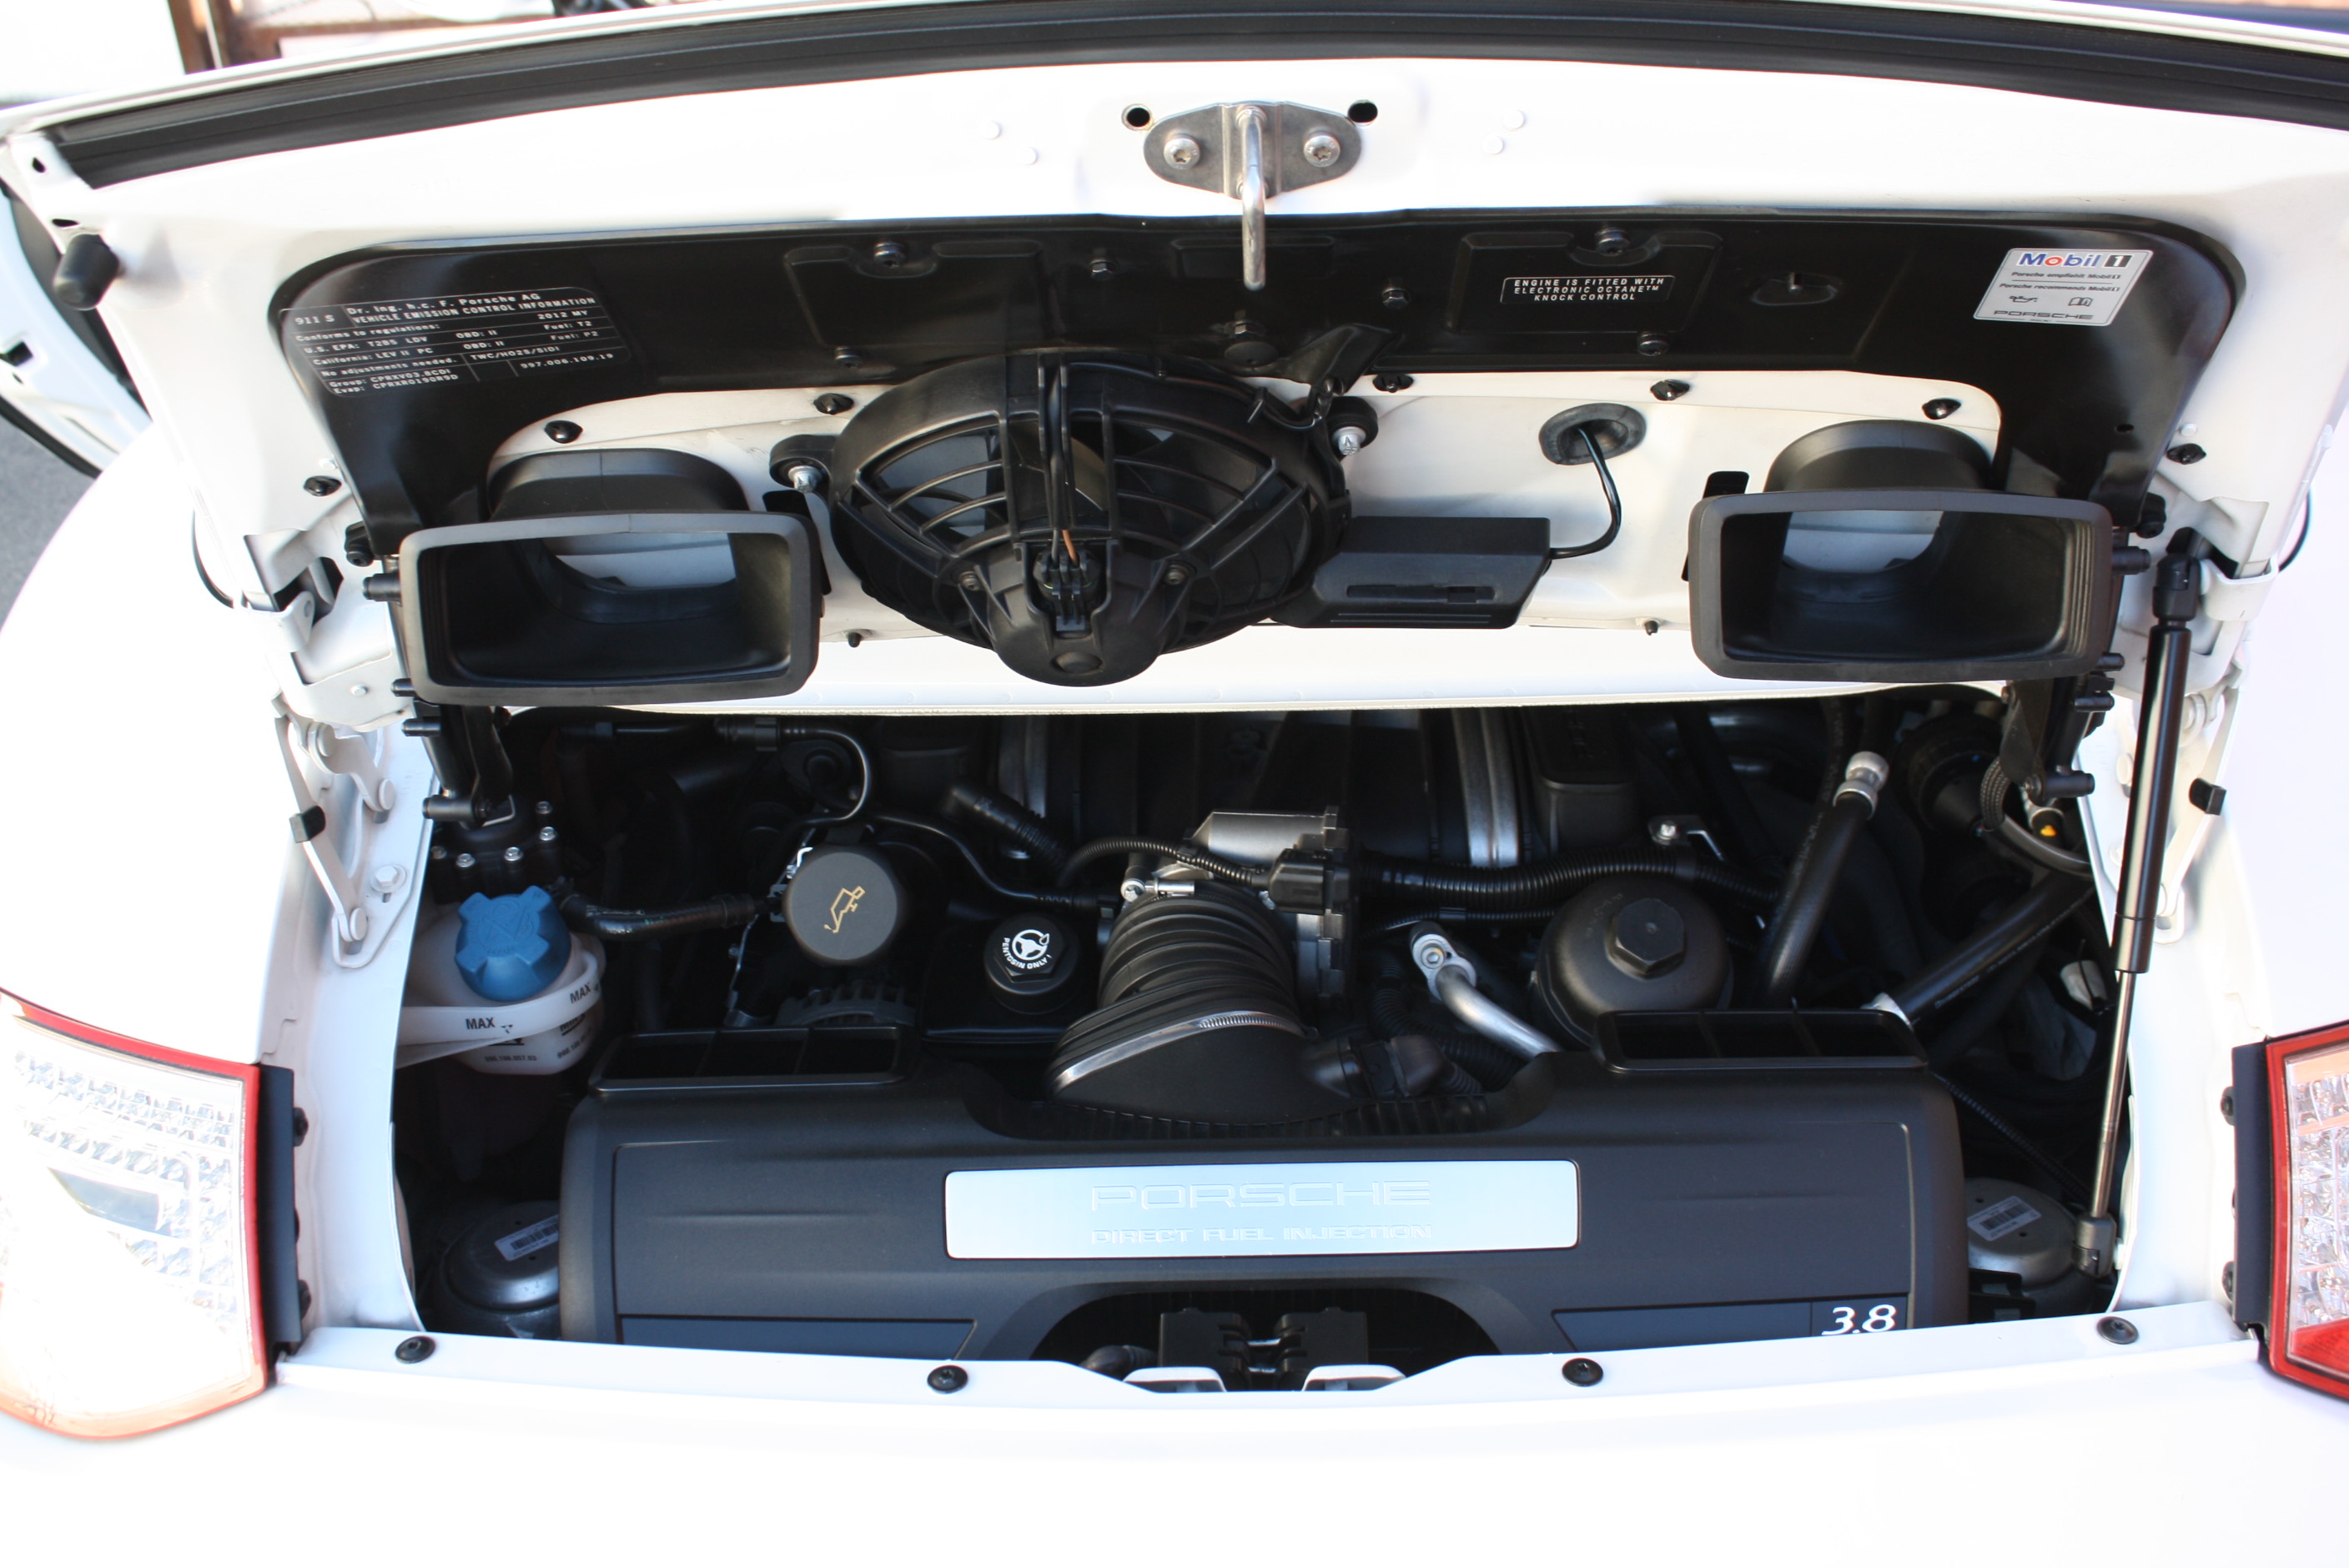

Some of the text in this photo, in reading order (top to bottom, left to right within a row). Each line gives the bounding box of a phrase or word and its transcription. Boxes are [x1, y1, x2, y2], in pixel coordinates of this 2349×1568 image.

[2018, 253, 2102, 267] Mobil
[1514, 279, 1560, 287] ENGINE
[2046, 272, 2085, 280] empfiehlt
[1514, 286, 1591, 294] ELECTRONIC
[346, 306, 370, 315] Dr.
[374, 304, 402, 314] Ing.
[405, 302, 435, 310] h.c.
[458, 296, 516, 306] Porsche
[351, 297, 596, 324] VEHICLE EMISSION CONTROL INFORMATION
[294, 314, 335, 325] 911 S
[537, 311, 568, 319] 2012
[1994, 310, 2094, 320] PORSCHE
[295, 331, 350, 342] Conforms
[370, 324, 440, 335] regulations:
[304, 346, 329, 354] U.S.
[332, 343, 360, 351] EPA:
[405, 336, 428, 344] LDV
[455, 331, 485, 339] OBD:
[313, 354, 373, 365] California:
[375, 351, 398, 359] LEV
[550, 333, 580, 341] Fuel:
[341, 362, 409, 376] adjustments
[412, 357, 457, 368] needed.
[329, 379, 368, 389] Group:
[333, 386, 366, 395] Evap:
[1002, 937, 1025, 968] PENTOSIN
[570, 983, 591, 1003] MAX
[465, 1017, 495, 1030] MAX
[1092, 1180, 1431, 1210] PORSCHE
[1092, 1222, 1432, 1244] DIRECT FUEL INJECTION
[1822, 1304, 1897, 1335] 3.8
